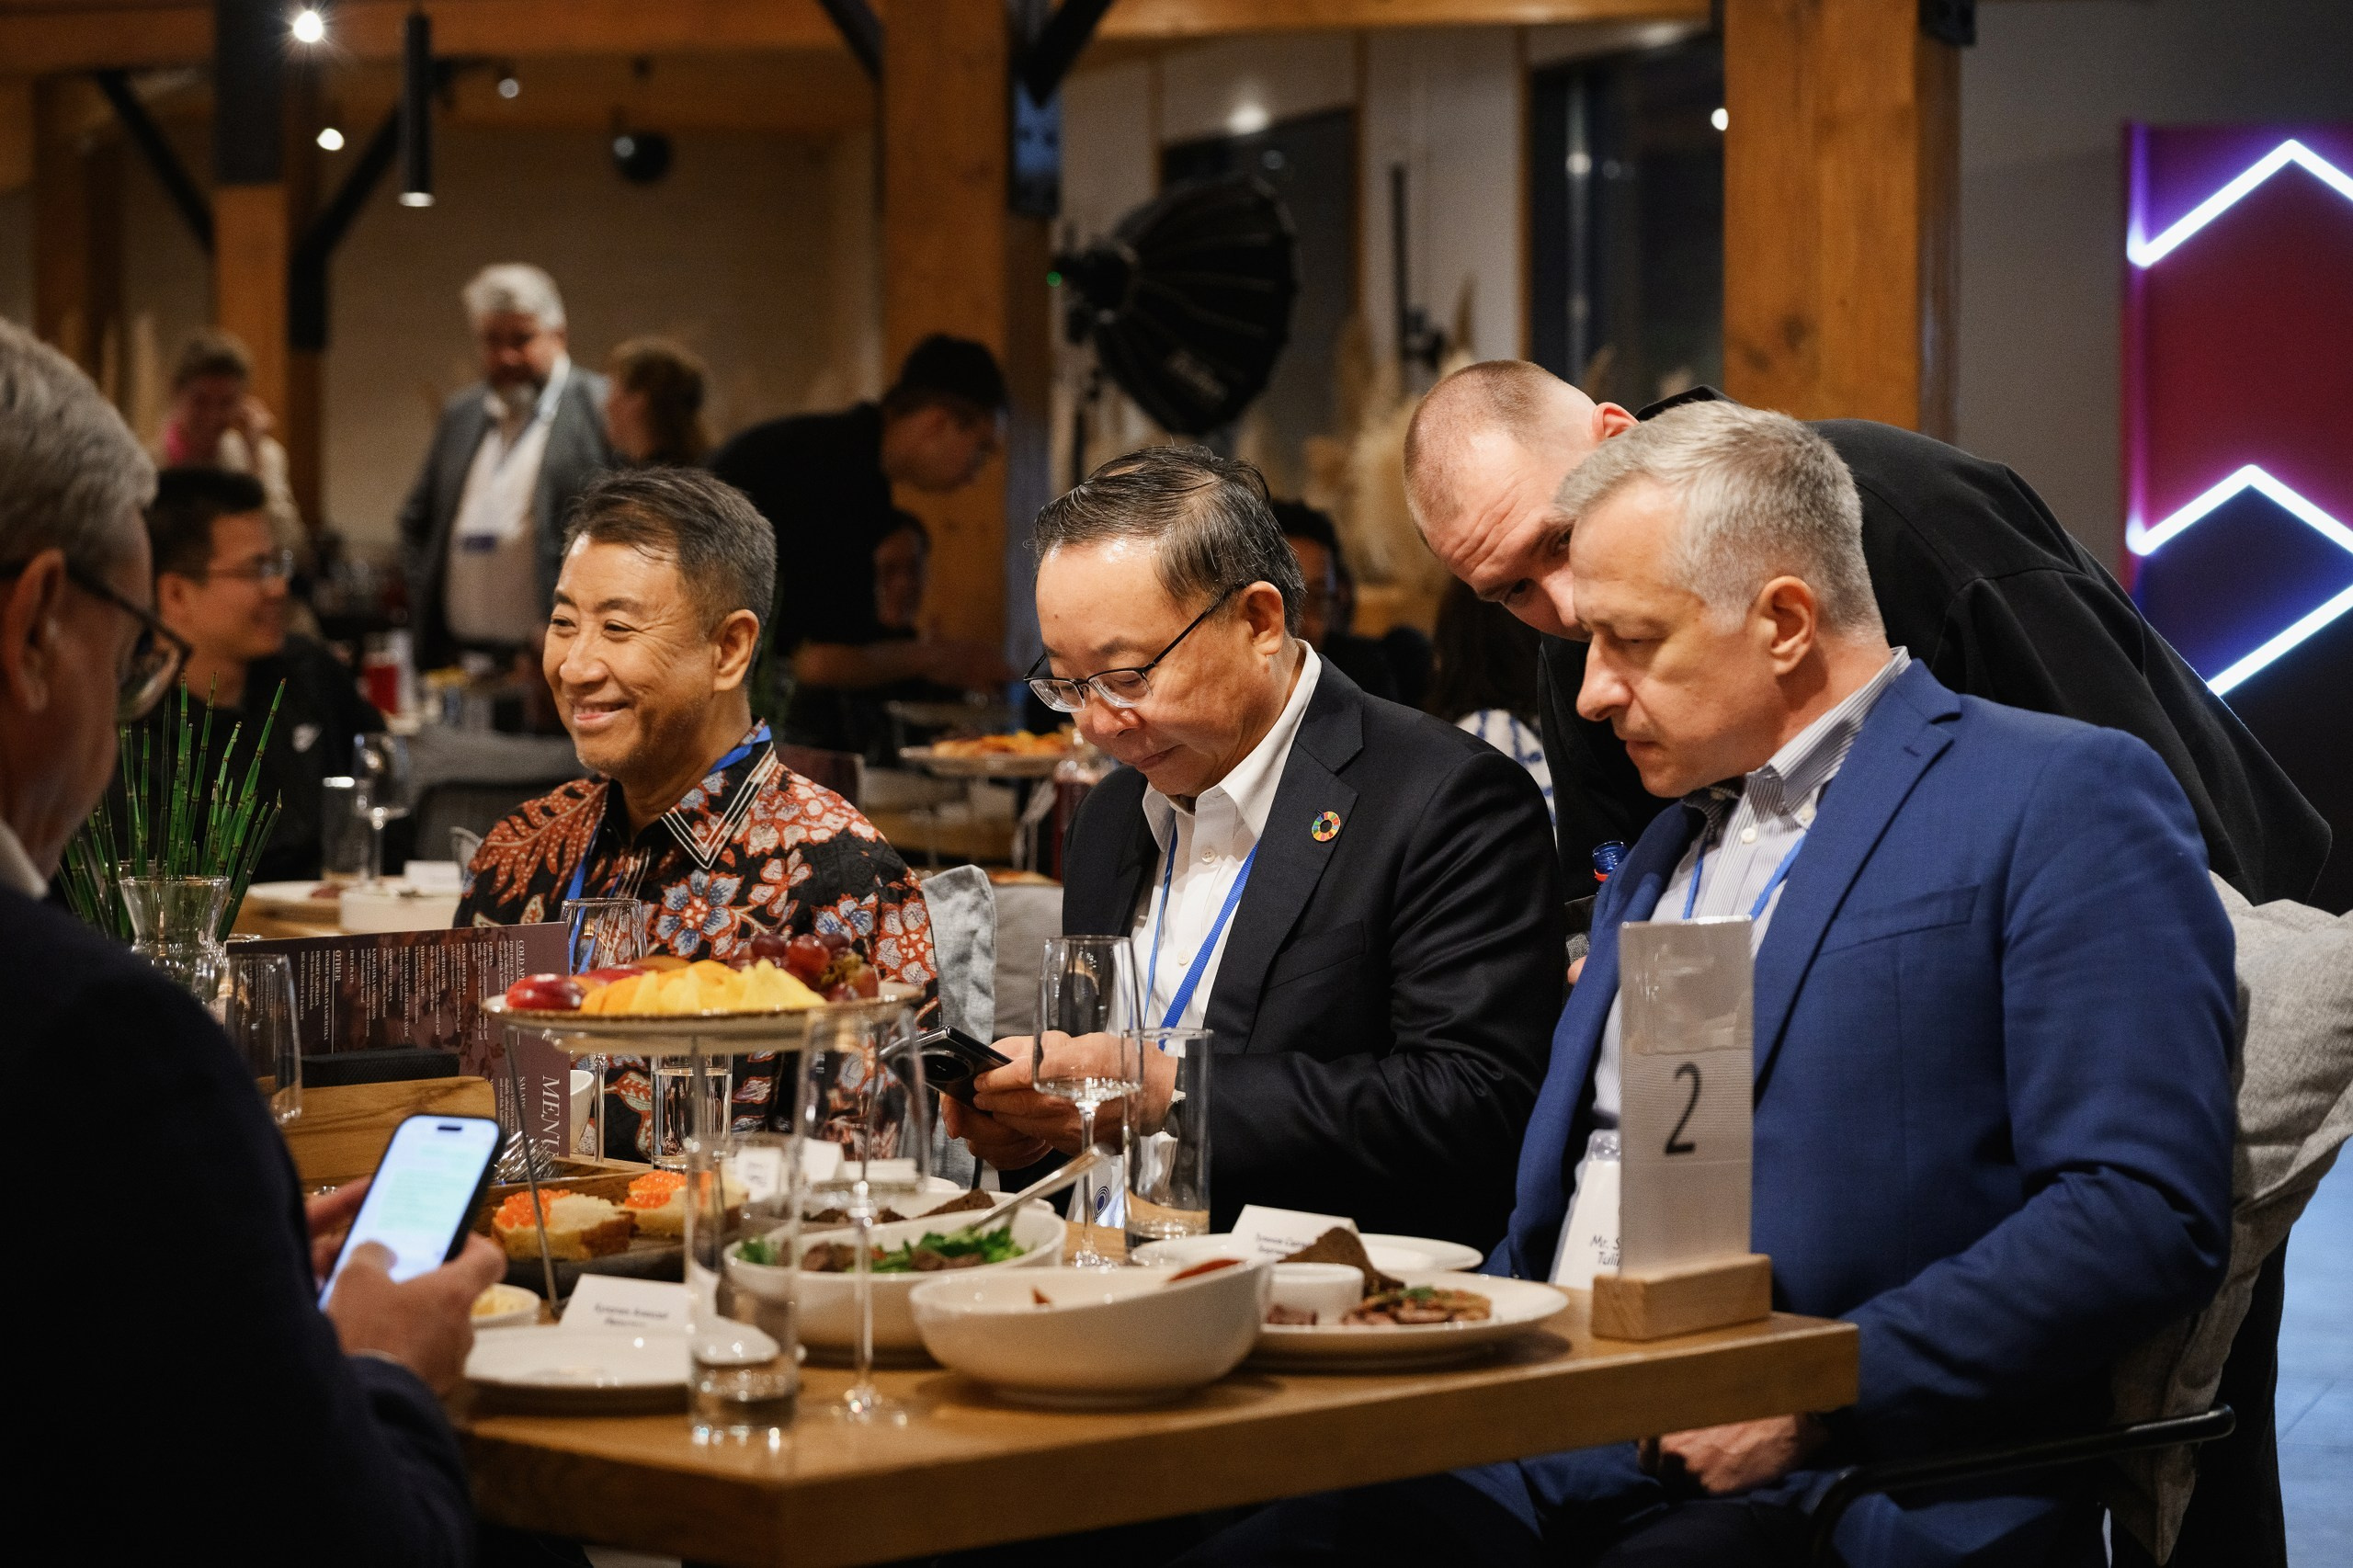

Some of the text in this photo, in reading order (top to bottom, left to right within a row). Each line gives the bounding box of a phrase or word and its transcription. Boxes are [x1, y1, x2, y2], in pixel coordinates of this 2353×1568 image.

[541, 1075, 560, 1156] MENU
[1665, 1062, 1701, 1156] 2
[1590, 1234, 1609, 1249] Mr.
